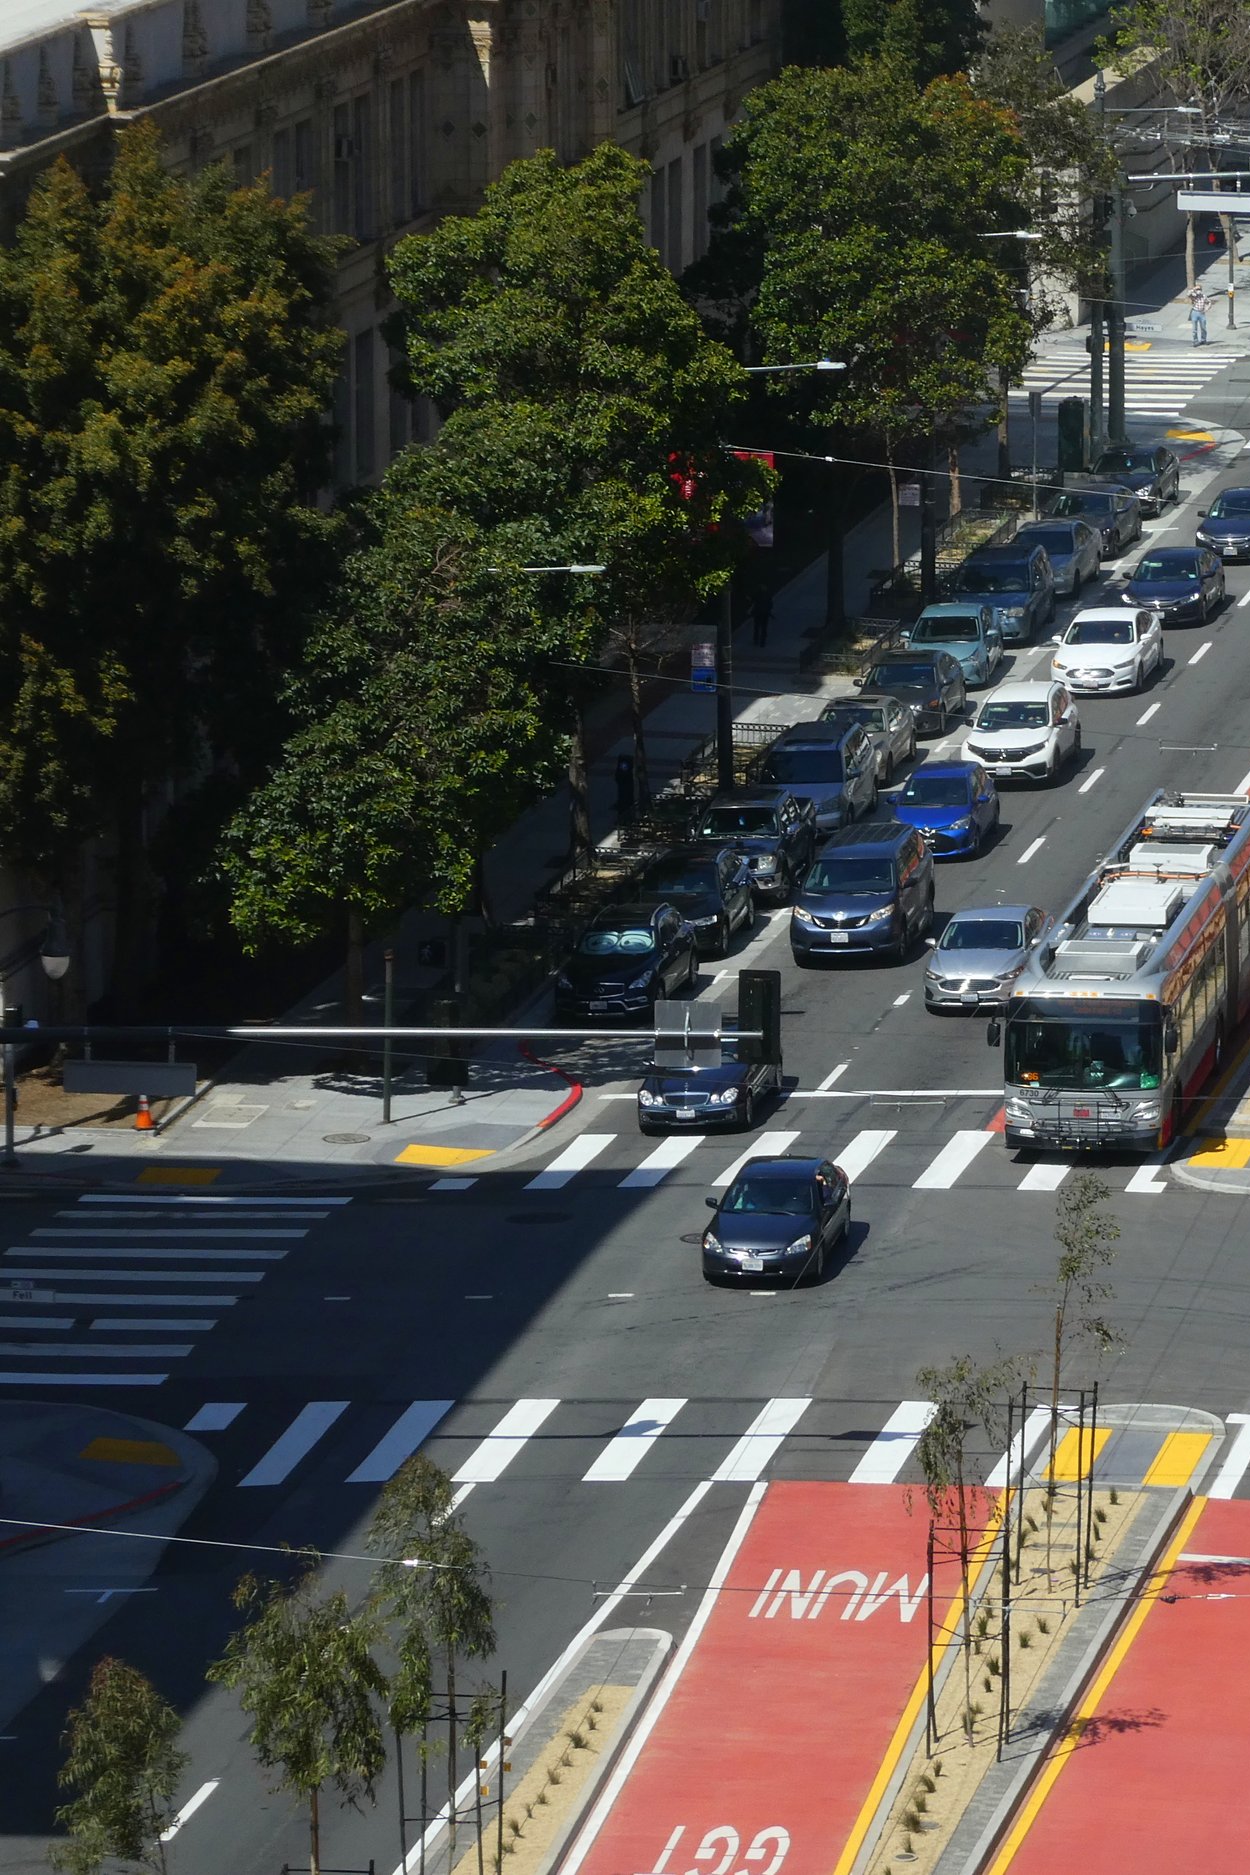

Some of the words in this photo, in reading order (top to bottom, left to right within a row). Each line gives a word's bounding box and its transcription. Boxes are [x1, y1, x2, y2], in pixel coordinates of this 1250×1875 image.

[1020, 1089, 1039, 1097] 6730
[748, 1568, 930, 1623] MUNI
[632, 1825, 790, 1875] GGT
